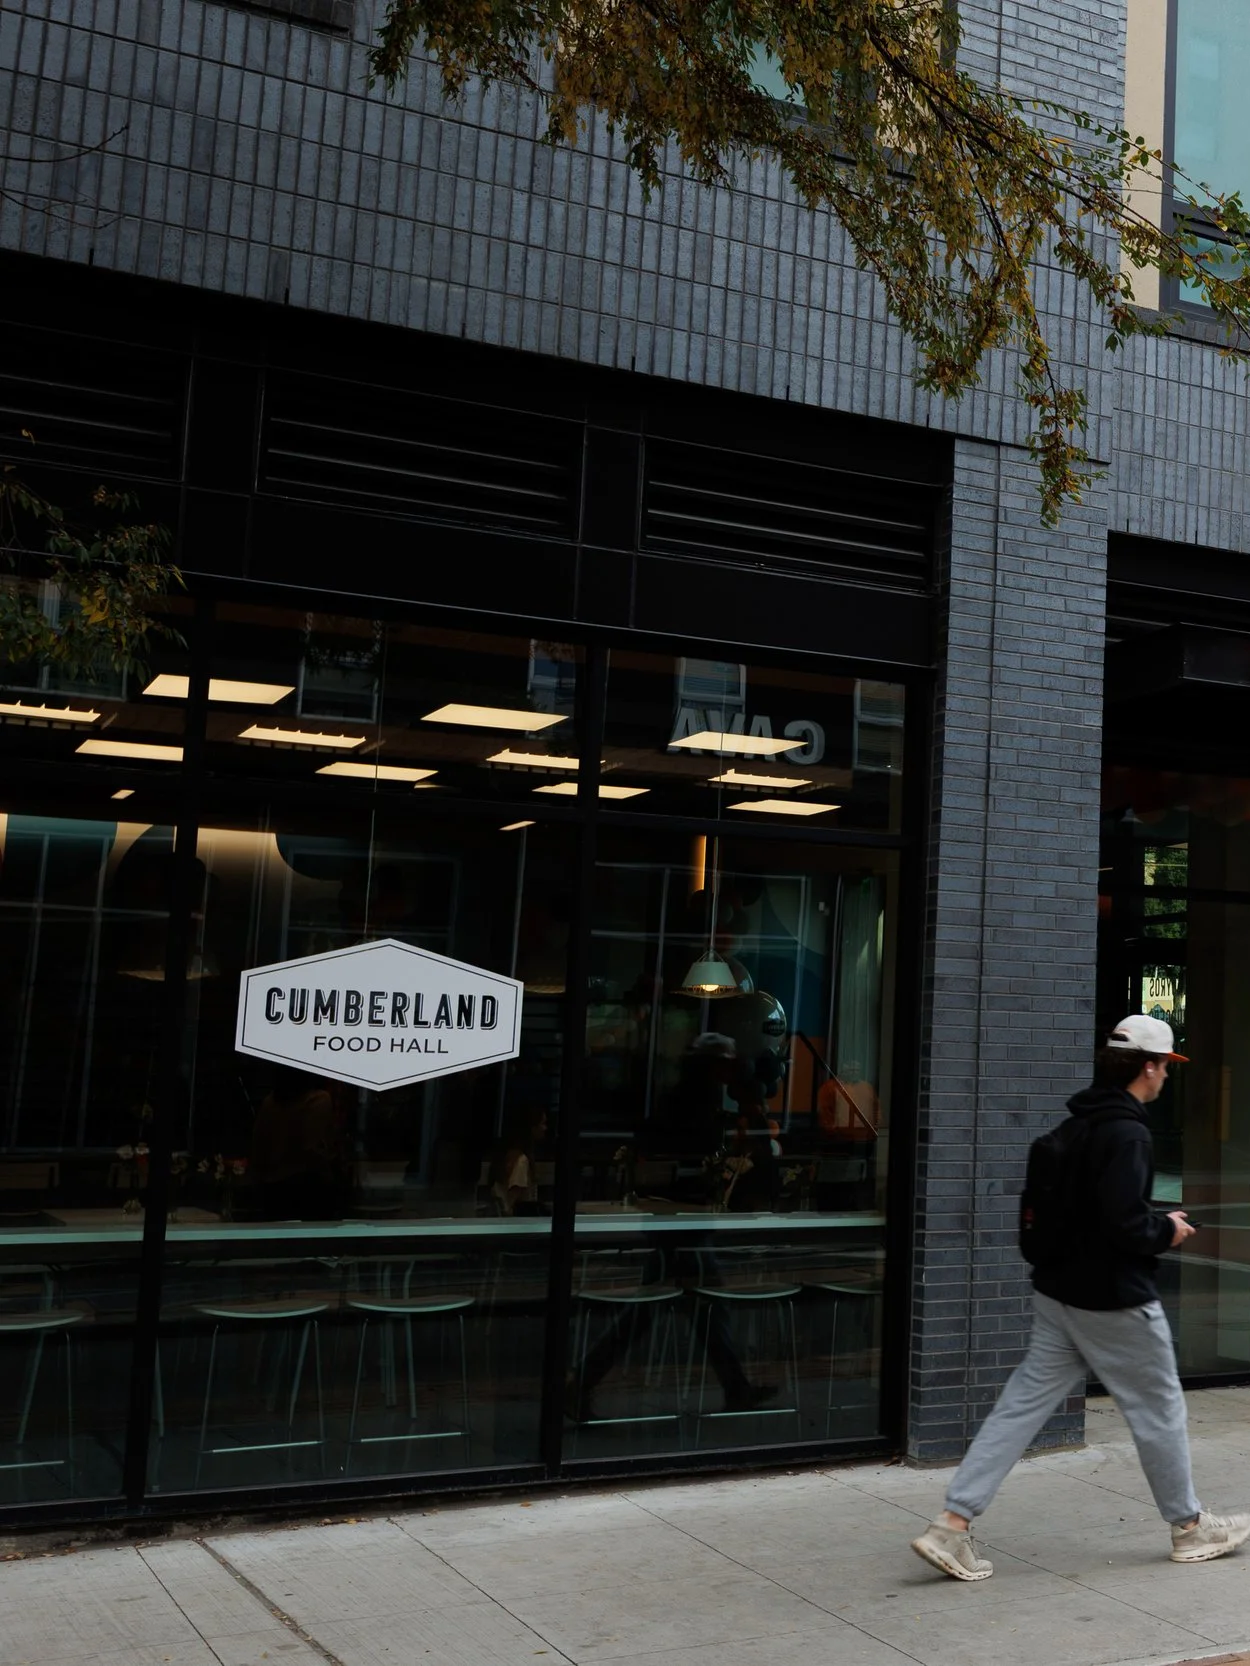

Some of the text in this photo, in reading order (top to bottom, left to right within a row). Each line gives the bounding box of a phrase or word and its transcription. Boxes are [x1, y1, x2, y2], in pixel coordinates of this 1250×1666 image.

[264, 986, 499, 1031] CUMBERLAND
[313, 1036, 449, 1054] FOOD HALL
